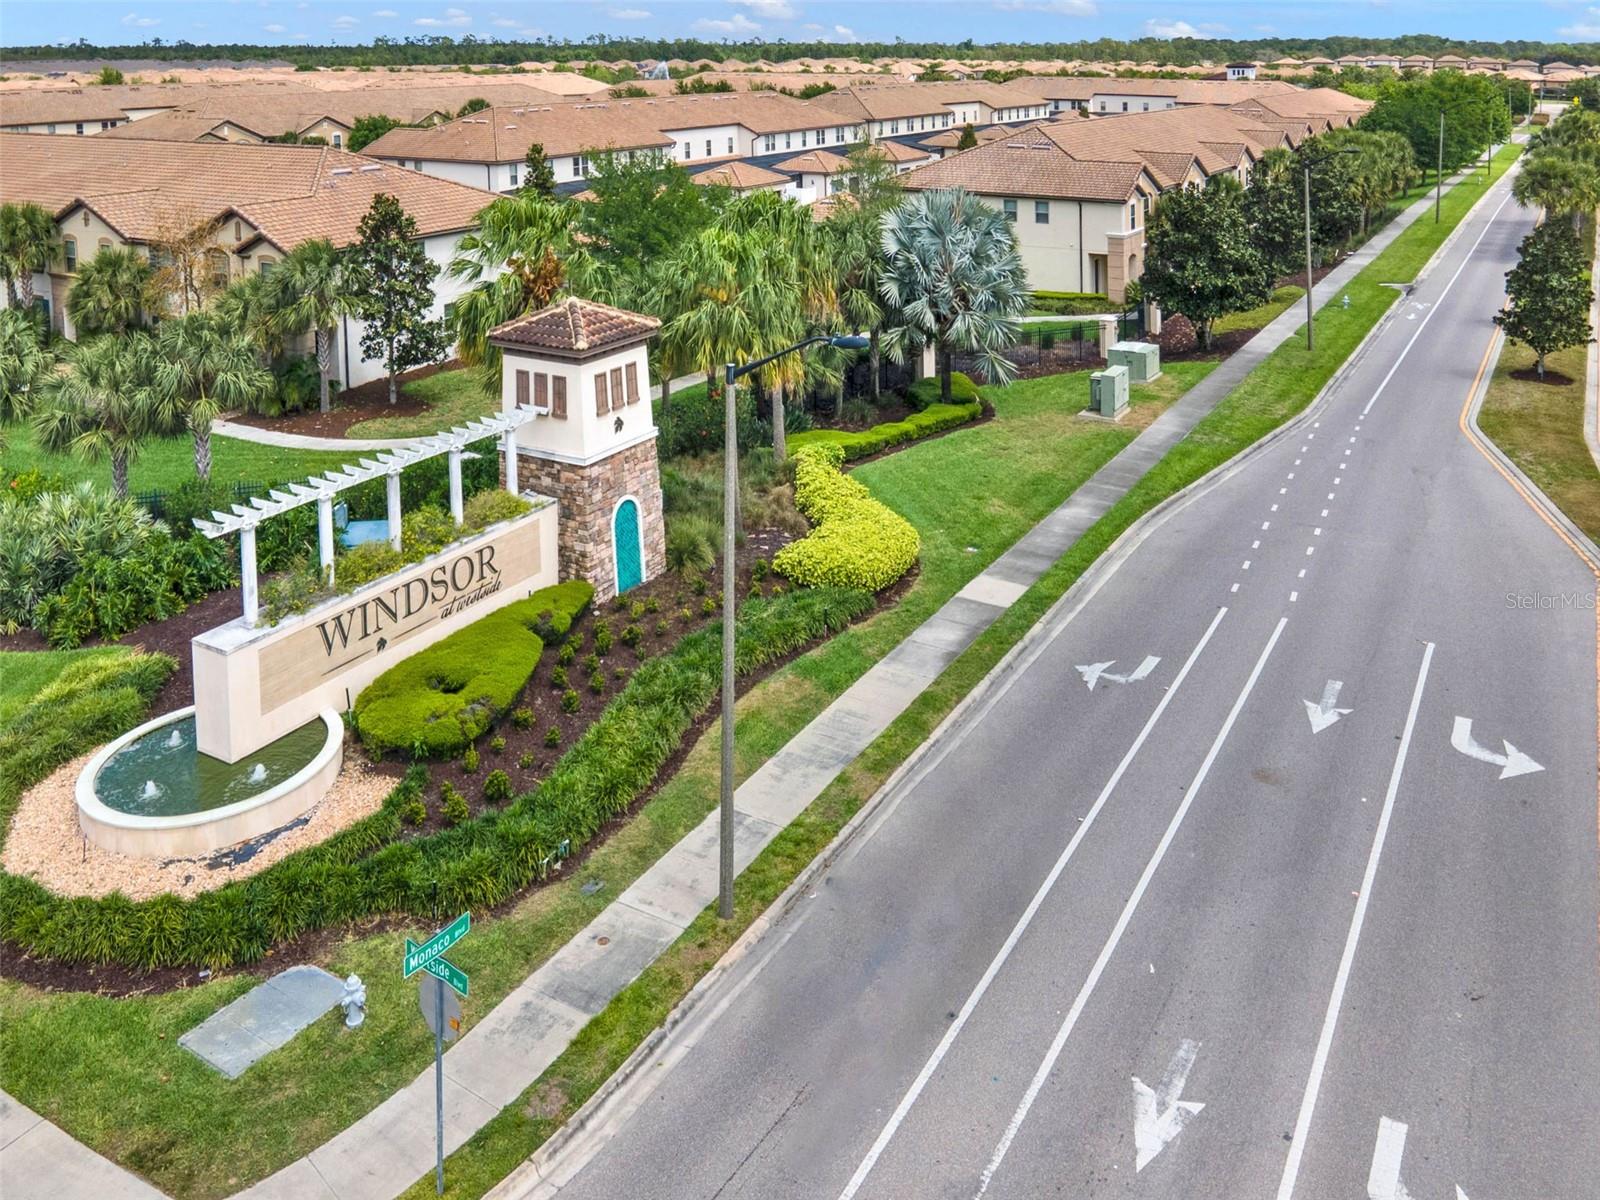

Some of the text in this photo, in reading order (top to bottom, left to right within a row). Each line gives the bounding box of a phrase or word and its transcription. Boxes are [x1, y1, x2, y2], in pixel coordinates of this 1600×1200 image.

[316, 545, 498, 657] WINDSOR
[439, 595, 458, 619] at
[409, 934, 450, 971] Monaco
